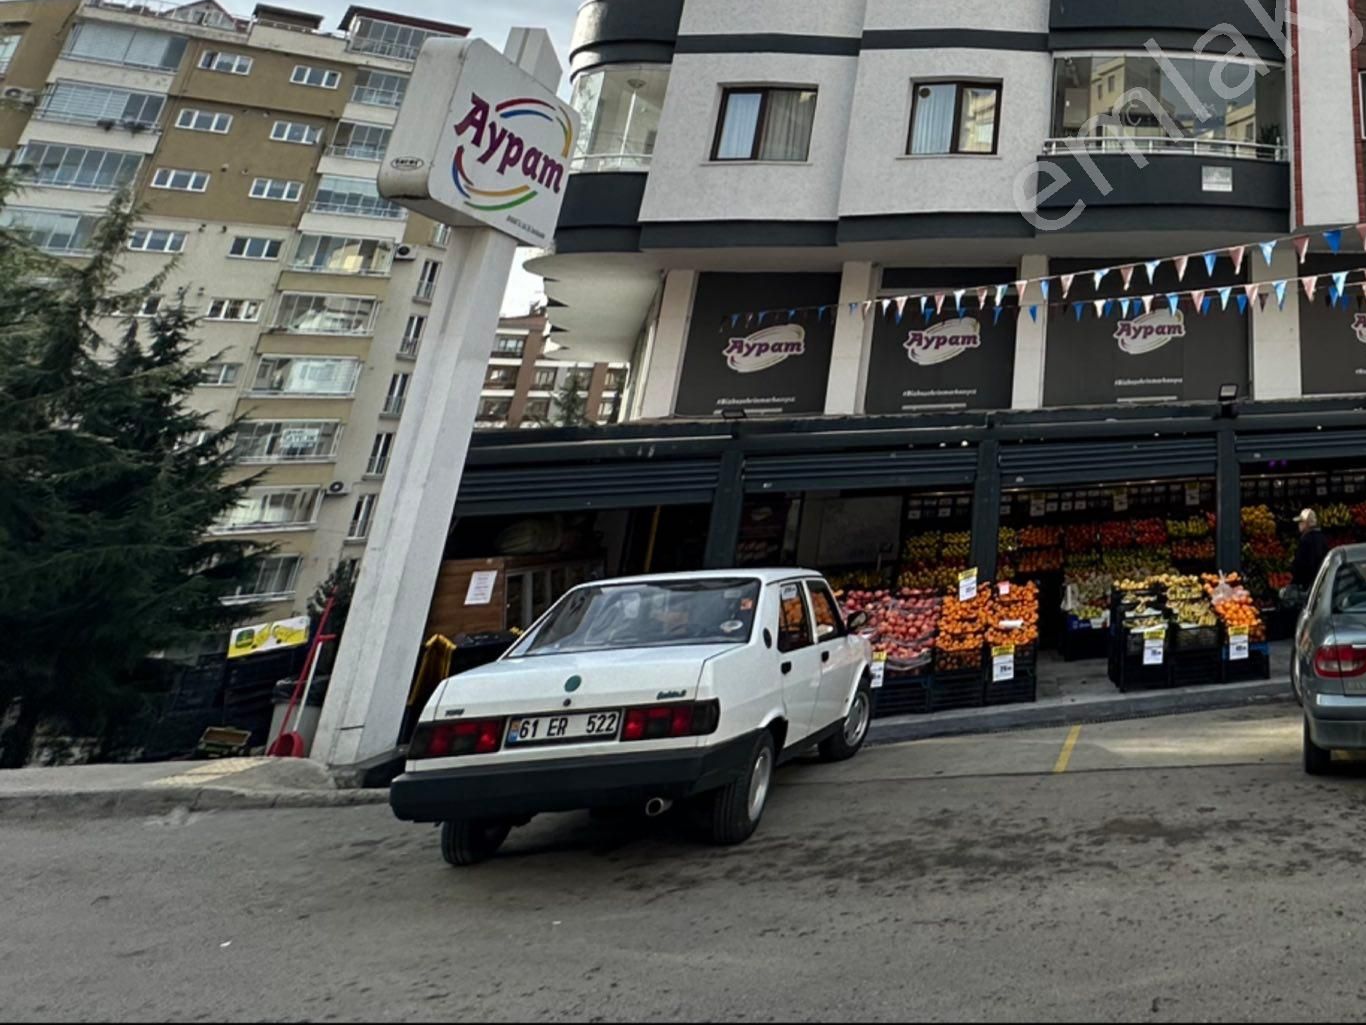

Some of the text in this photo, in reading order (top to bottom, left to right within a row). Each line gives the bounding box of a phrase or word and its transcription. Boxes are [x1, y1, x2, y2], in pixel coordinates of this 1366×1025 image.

[454, 92, 564, 194] Aypam
[907, 331, 979, 350] Aypam
[1116, 322, 1183, 340] Aypam
[726, 338, 803, 357] Aypam
[520, 713, 617, 738] 61 ER 522
